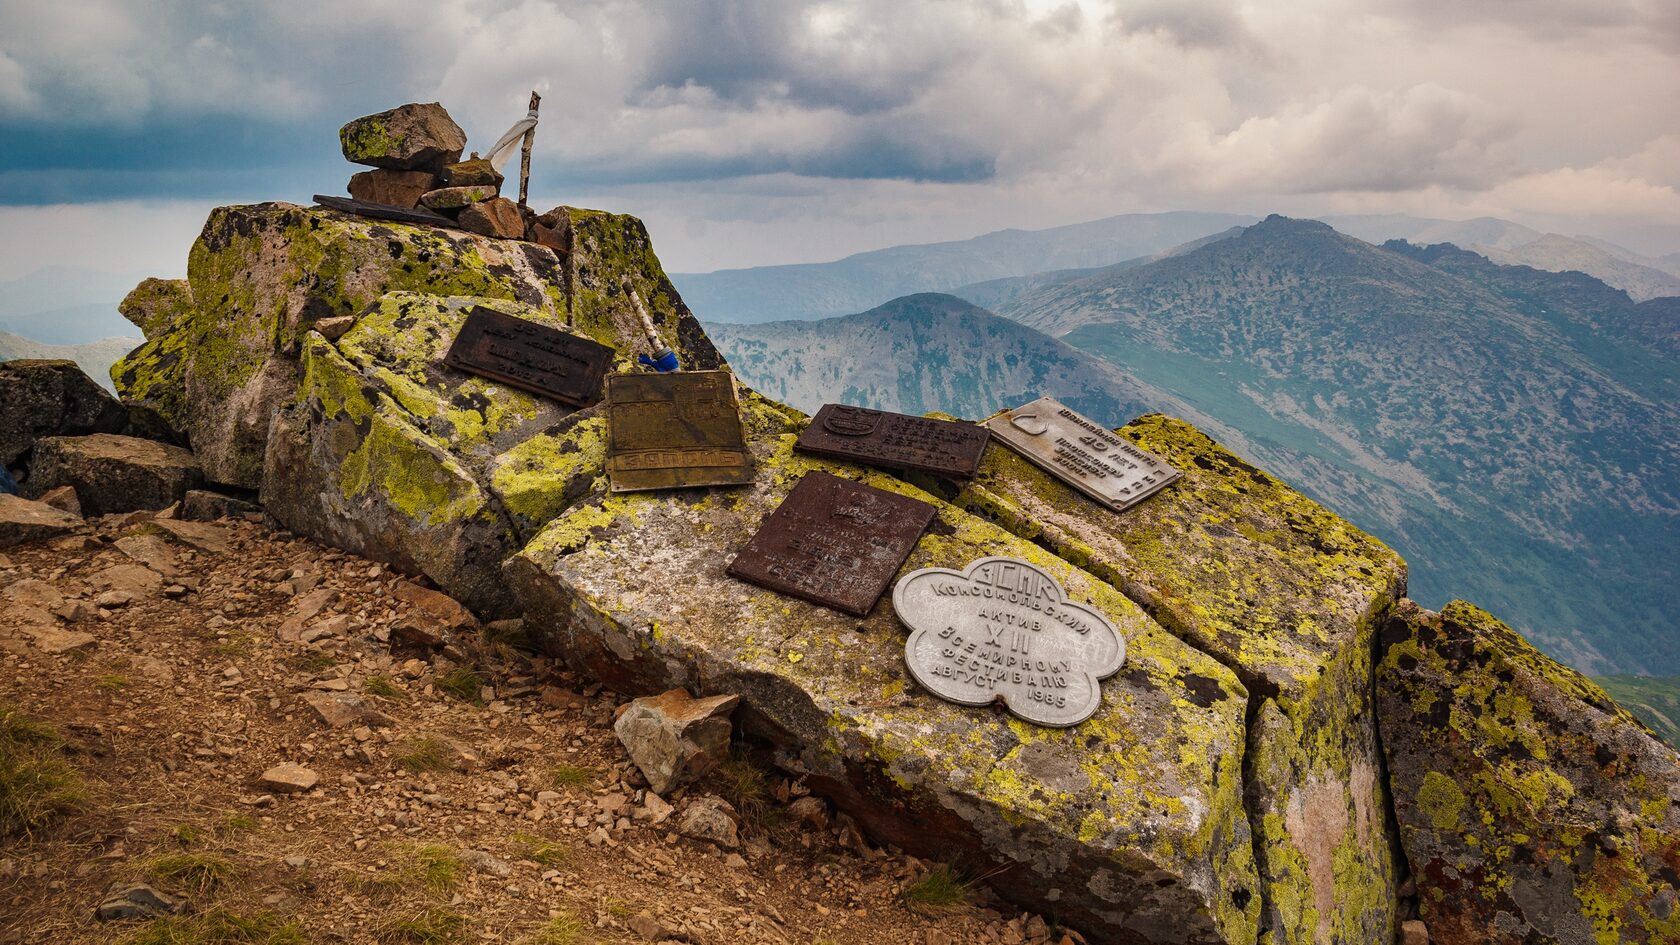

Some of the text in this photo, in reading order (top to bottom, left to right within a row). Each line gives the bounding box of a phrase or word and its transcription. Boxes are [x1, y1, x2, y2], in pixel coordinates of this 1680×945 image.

[1079, 436, 1138, 470] 40 ЛЕТ
[975, 563, 1055, 602] ЗСМК
[978, 607, 1042, 632] АКТИВ
[938, 626, 1072, 674] ВСЕМИРНОМУ
[931, 663, 1066, 708] АВГУСТ 1985
